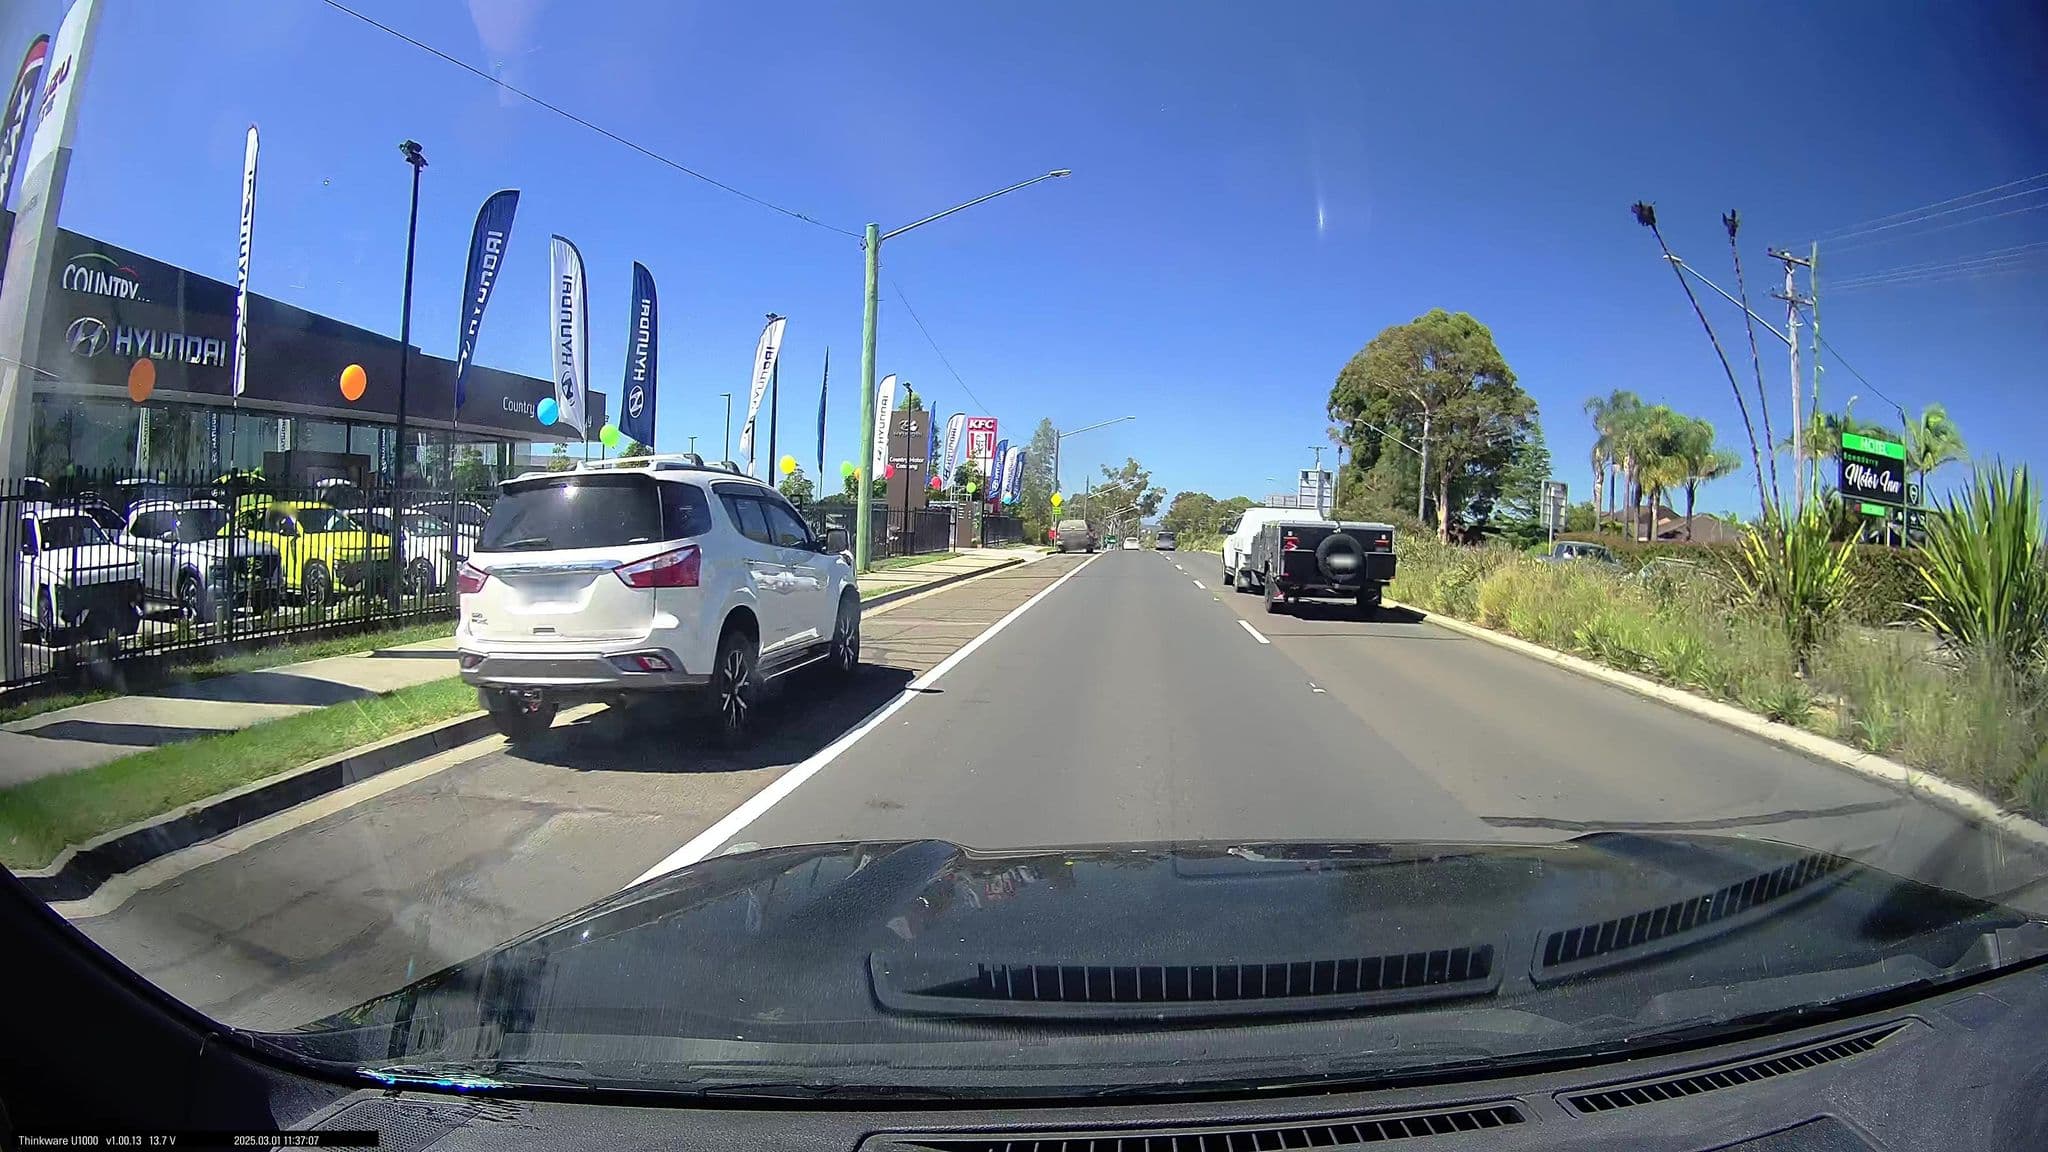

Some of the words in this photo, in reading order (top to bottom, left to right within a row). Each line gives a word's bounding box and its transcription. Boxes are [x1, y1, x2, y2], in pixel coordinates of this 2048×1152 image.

[114, 324, 227, 367] HYUNDAI
[502, 396, 536, 418] Country
[969, 419, 995, 429] KFC
[1845, 463, 1879, 491] Motor
[1880, 470, 1901, 494] Inn
